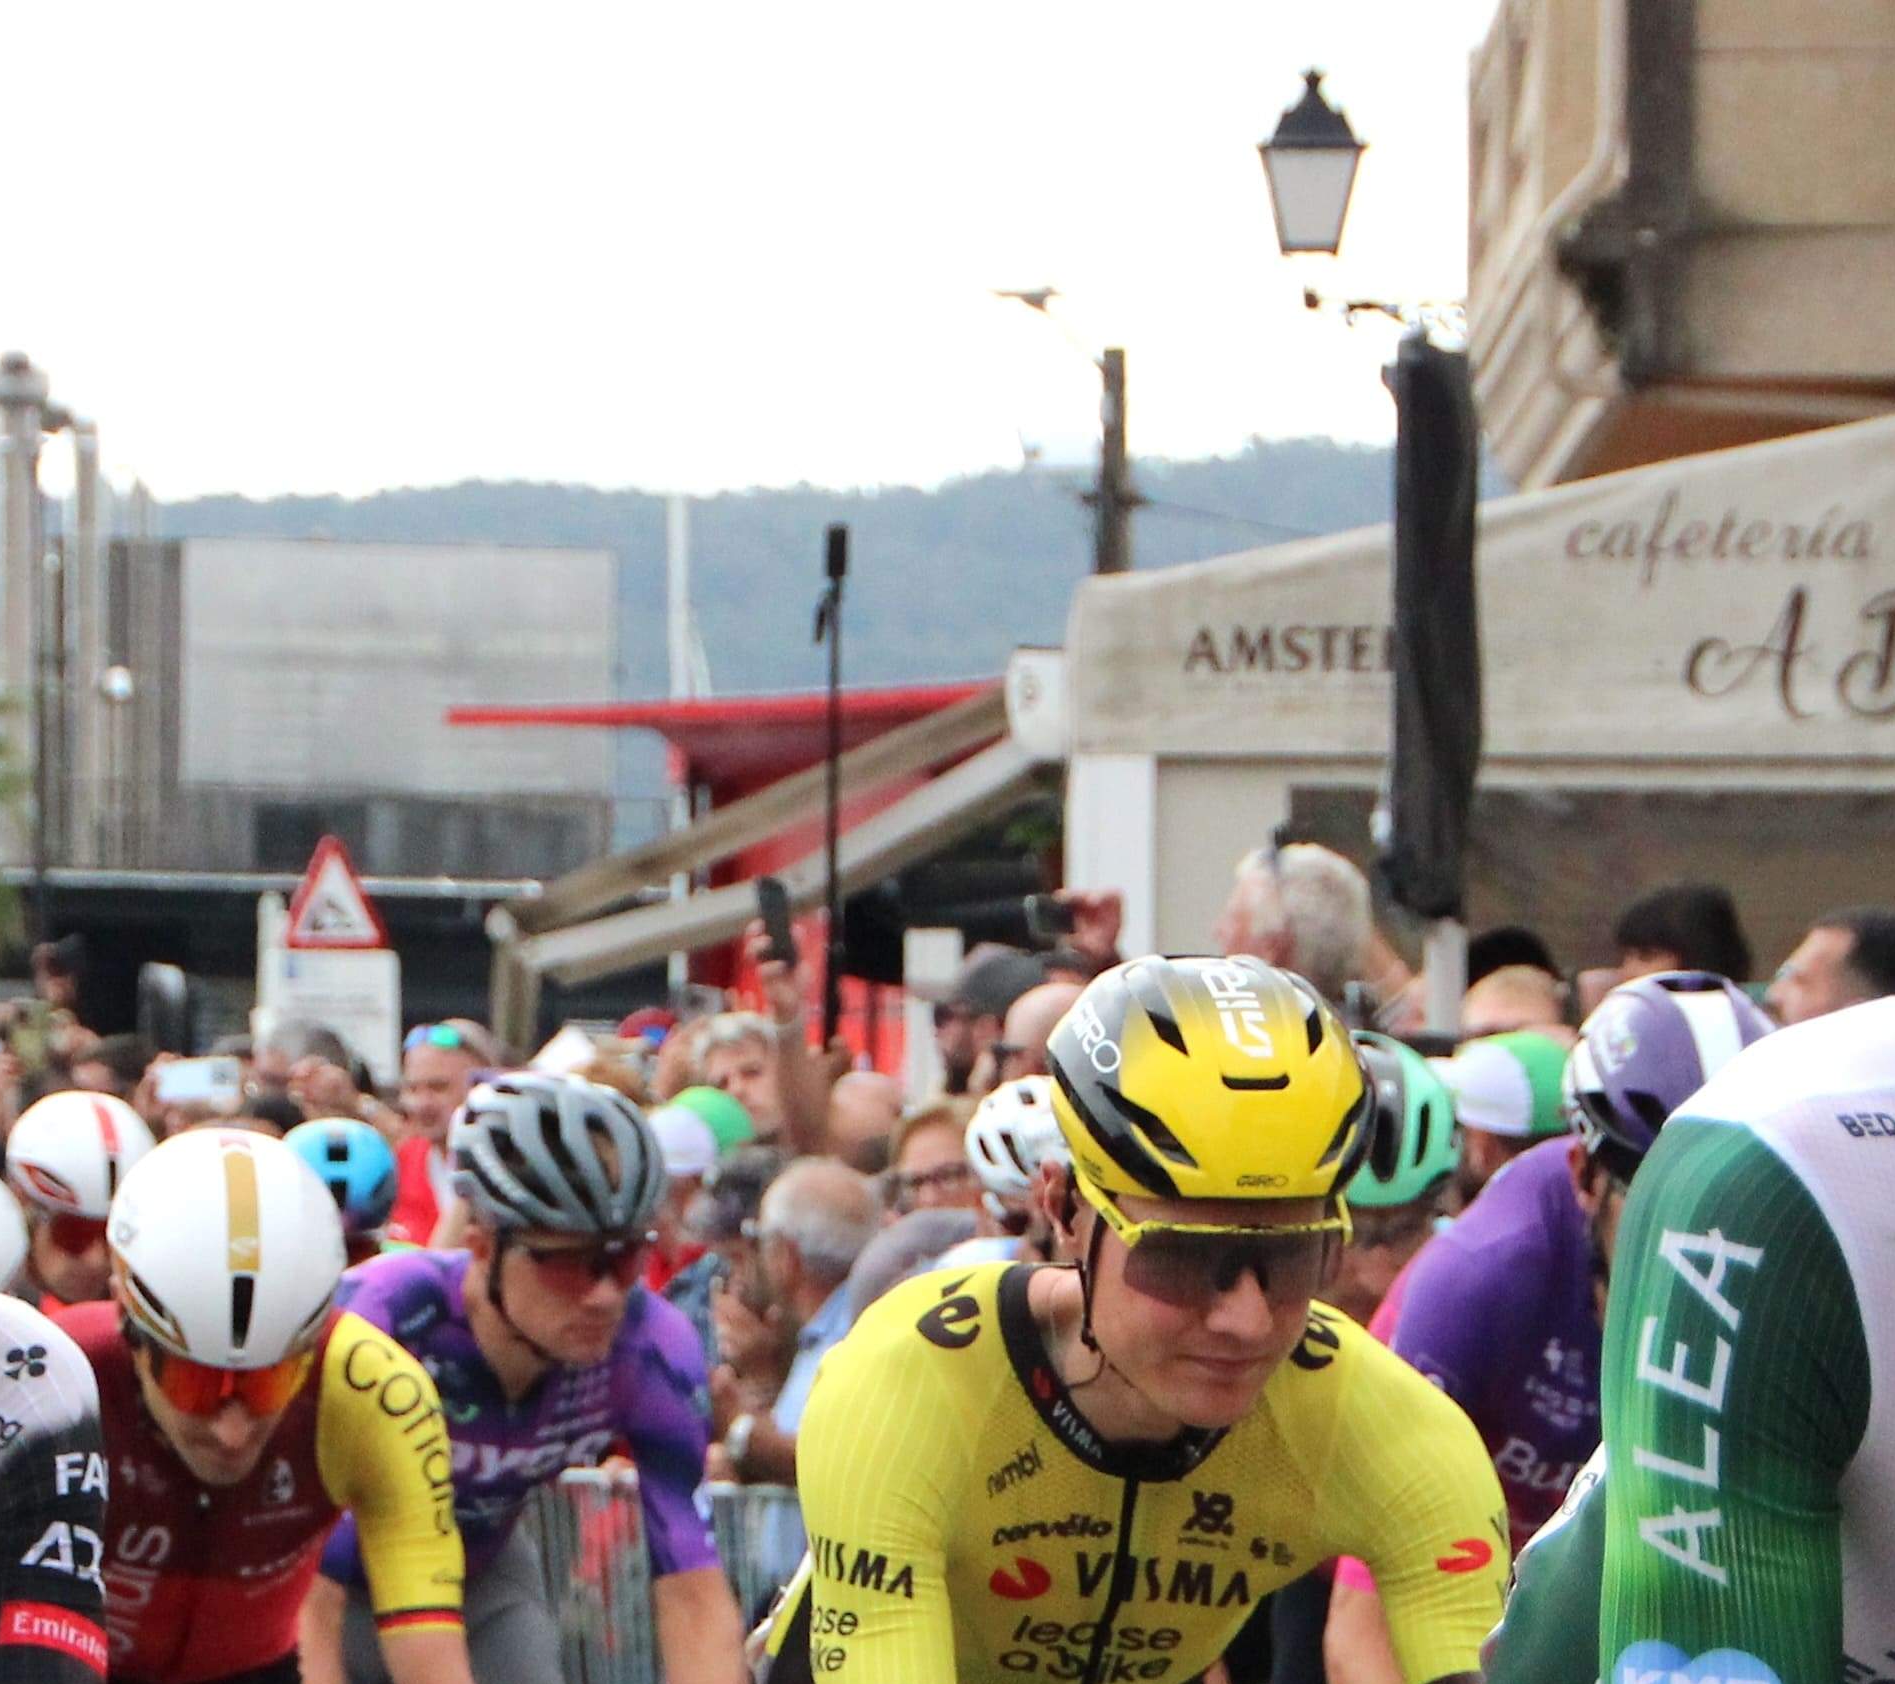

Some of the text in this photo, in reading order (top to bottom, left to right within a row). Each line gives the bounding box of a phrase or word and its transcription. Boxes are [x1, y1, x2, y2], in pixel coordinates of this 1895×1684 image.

[1632, 1227, 1764, 1586] ALEA
[811, 1533, 915, 1599] VISMA
[1075, 1551, 1251, 1608] VISMA
[1012, 1614, 1183, 1652] lease
